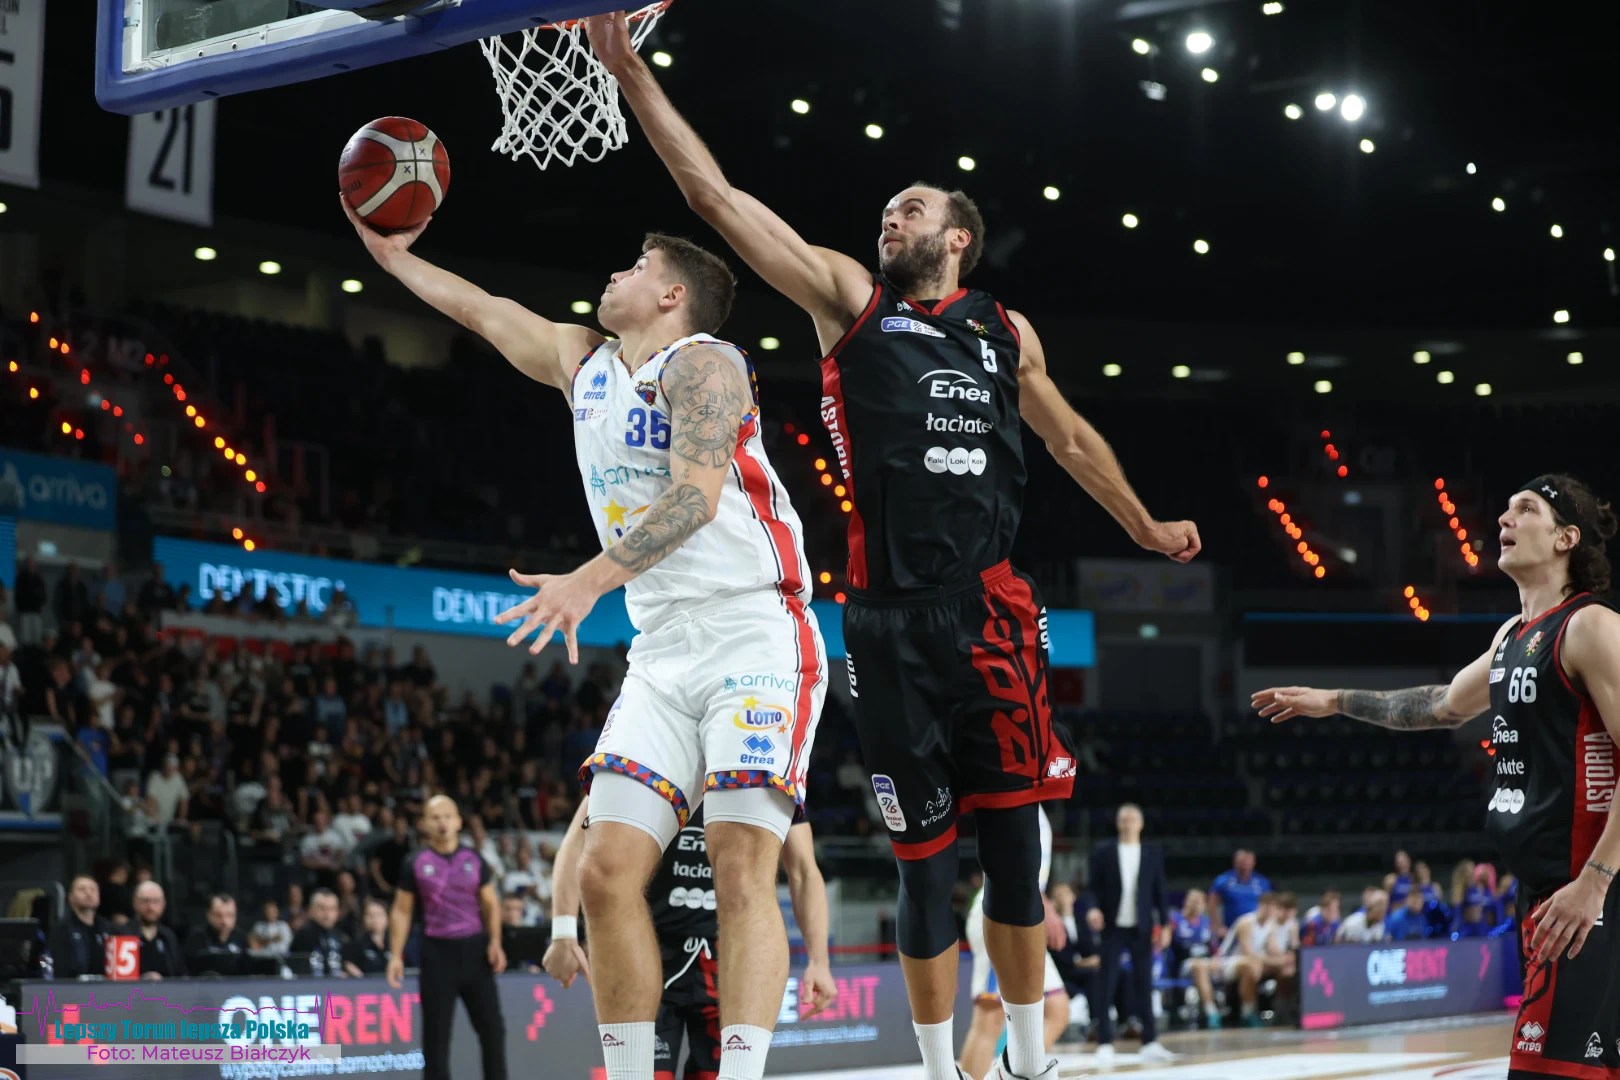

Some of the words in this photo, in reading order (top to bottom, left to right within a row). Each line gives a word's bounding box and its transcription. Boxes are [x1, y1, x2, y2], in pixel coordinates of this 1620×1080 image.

[978, 337, 998, 373] 5
[583, 391, 606, 400] errea
[930, 380, 990, 404] Enea
[625, 408, 671, 449] 35
[926, 412, 992, 433] łaciate
[928, 456, 944, 464] Fale
[740, 674, 795, 693] arriva
[1508, 667, 1537, 703] 66
[746, 710, 782, 726] LOTTO
[740, 753, 775, 765] errea
[1583, 731, 1616, 812] ASTORIA
[677, 834, 706, 852] En
[673, 861, 712, 878] łacia
[116, 940, 138, 976] 5
[722, 1044, 752, 1052] PEAK
[1517, 1040, 1541, 1052] errea
